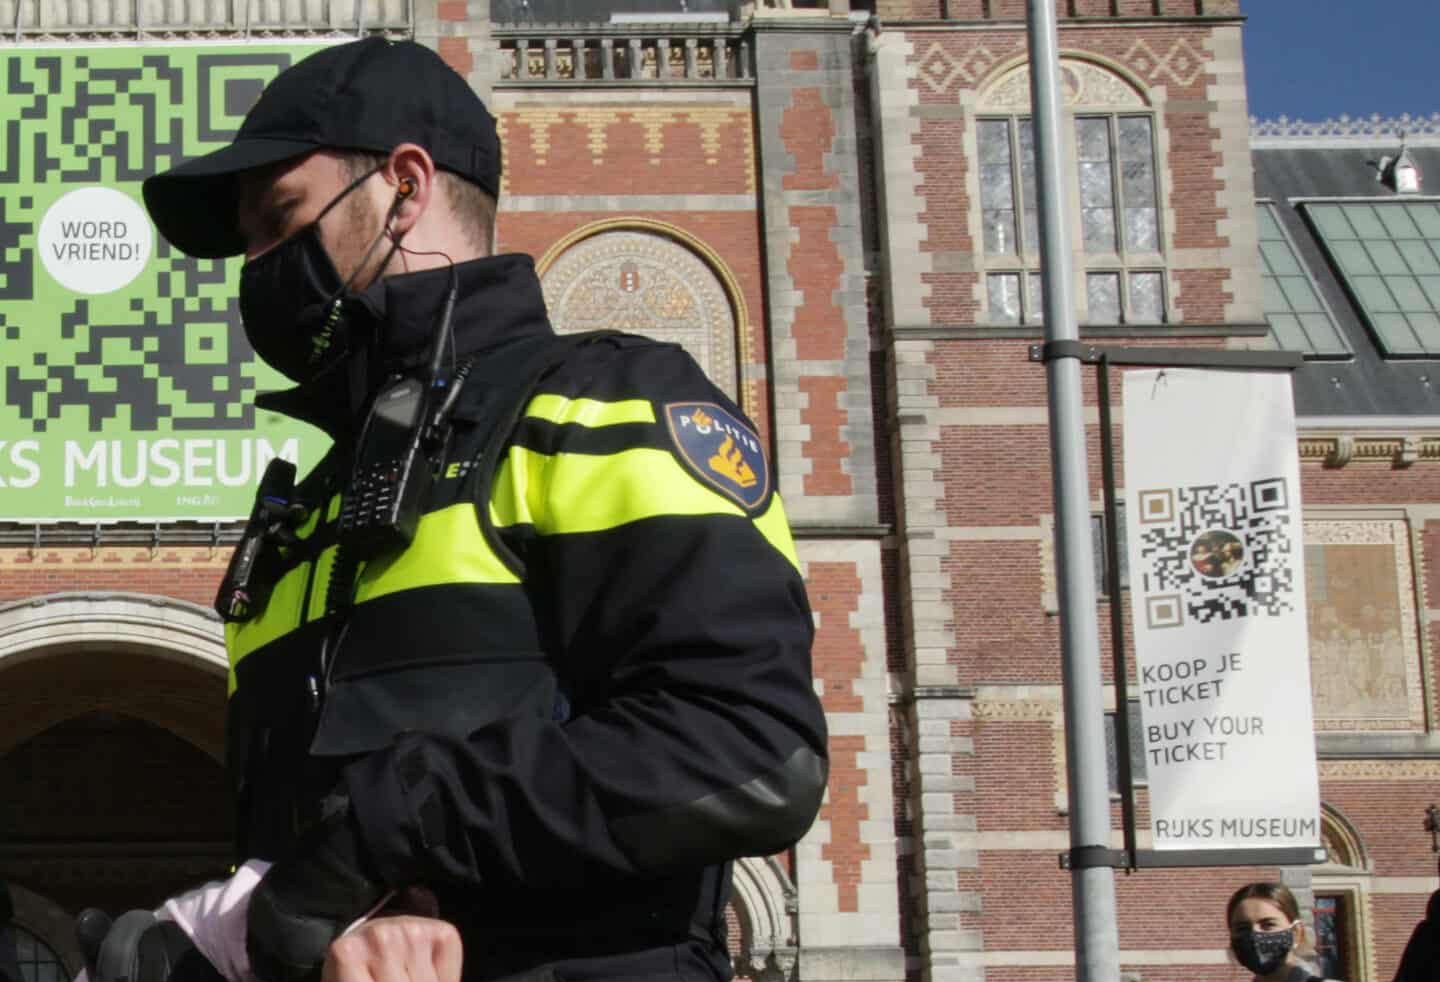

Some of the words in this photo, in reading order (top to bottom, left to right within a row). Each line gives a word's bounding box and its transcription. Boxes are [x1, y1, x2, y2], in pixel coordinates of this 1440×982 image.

[61, 221, 127, 239] WORD
[52, 243, 140, 260] VRIEND!
[679, 415, 759, 453] POLITIE
[64, 438, 299, 488] MUSEUM
[1142, 658, 1207, 684] KOOP
[1216, 653, 1243, 673] JE
[1144, 679, 1224, 707] TICKET
[1148, 719, 1195, 743] BUY
[1203, 716, 1264, 735] YOUR
[1149, 742, 1227, 766] TICKET
[1156, 818, 1214, 838] RIJKS
[1220, 817, 1315, 838] MUSEUM
